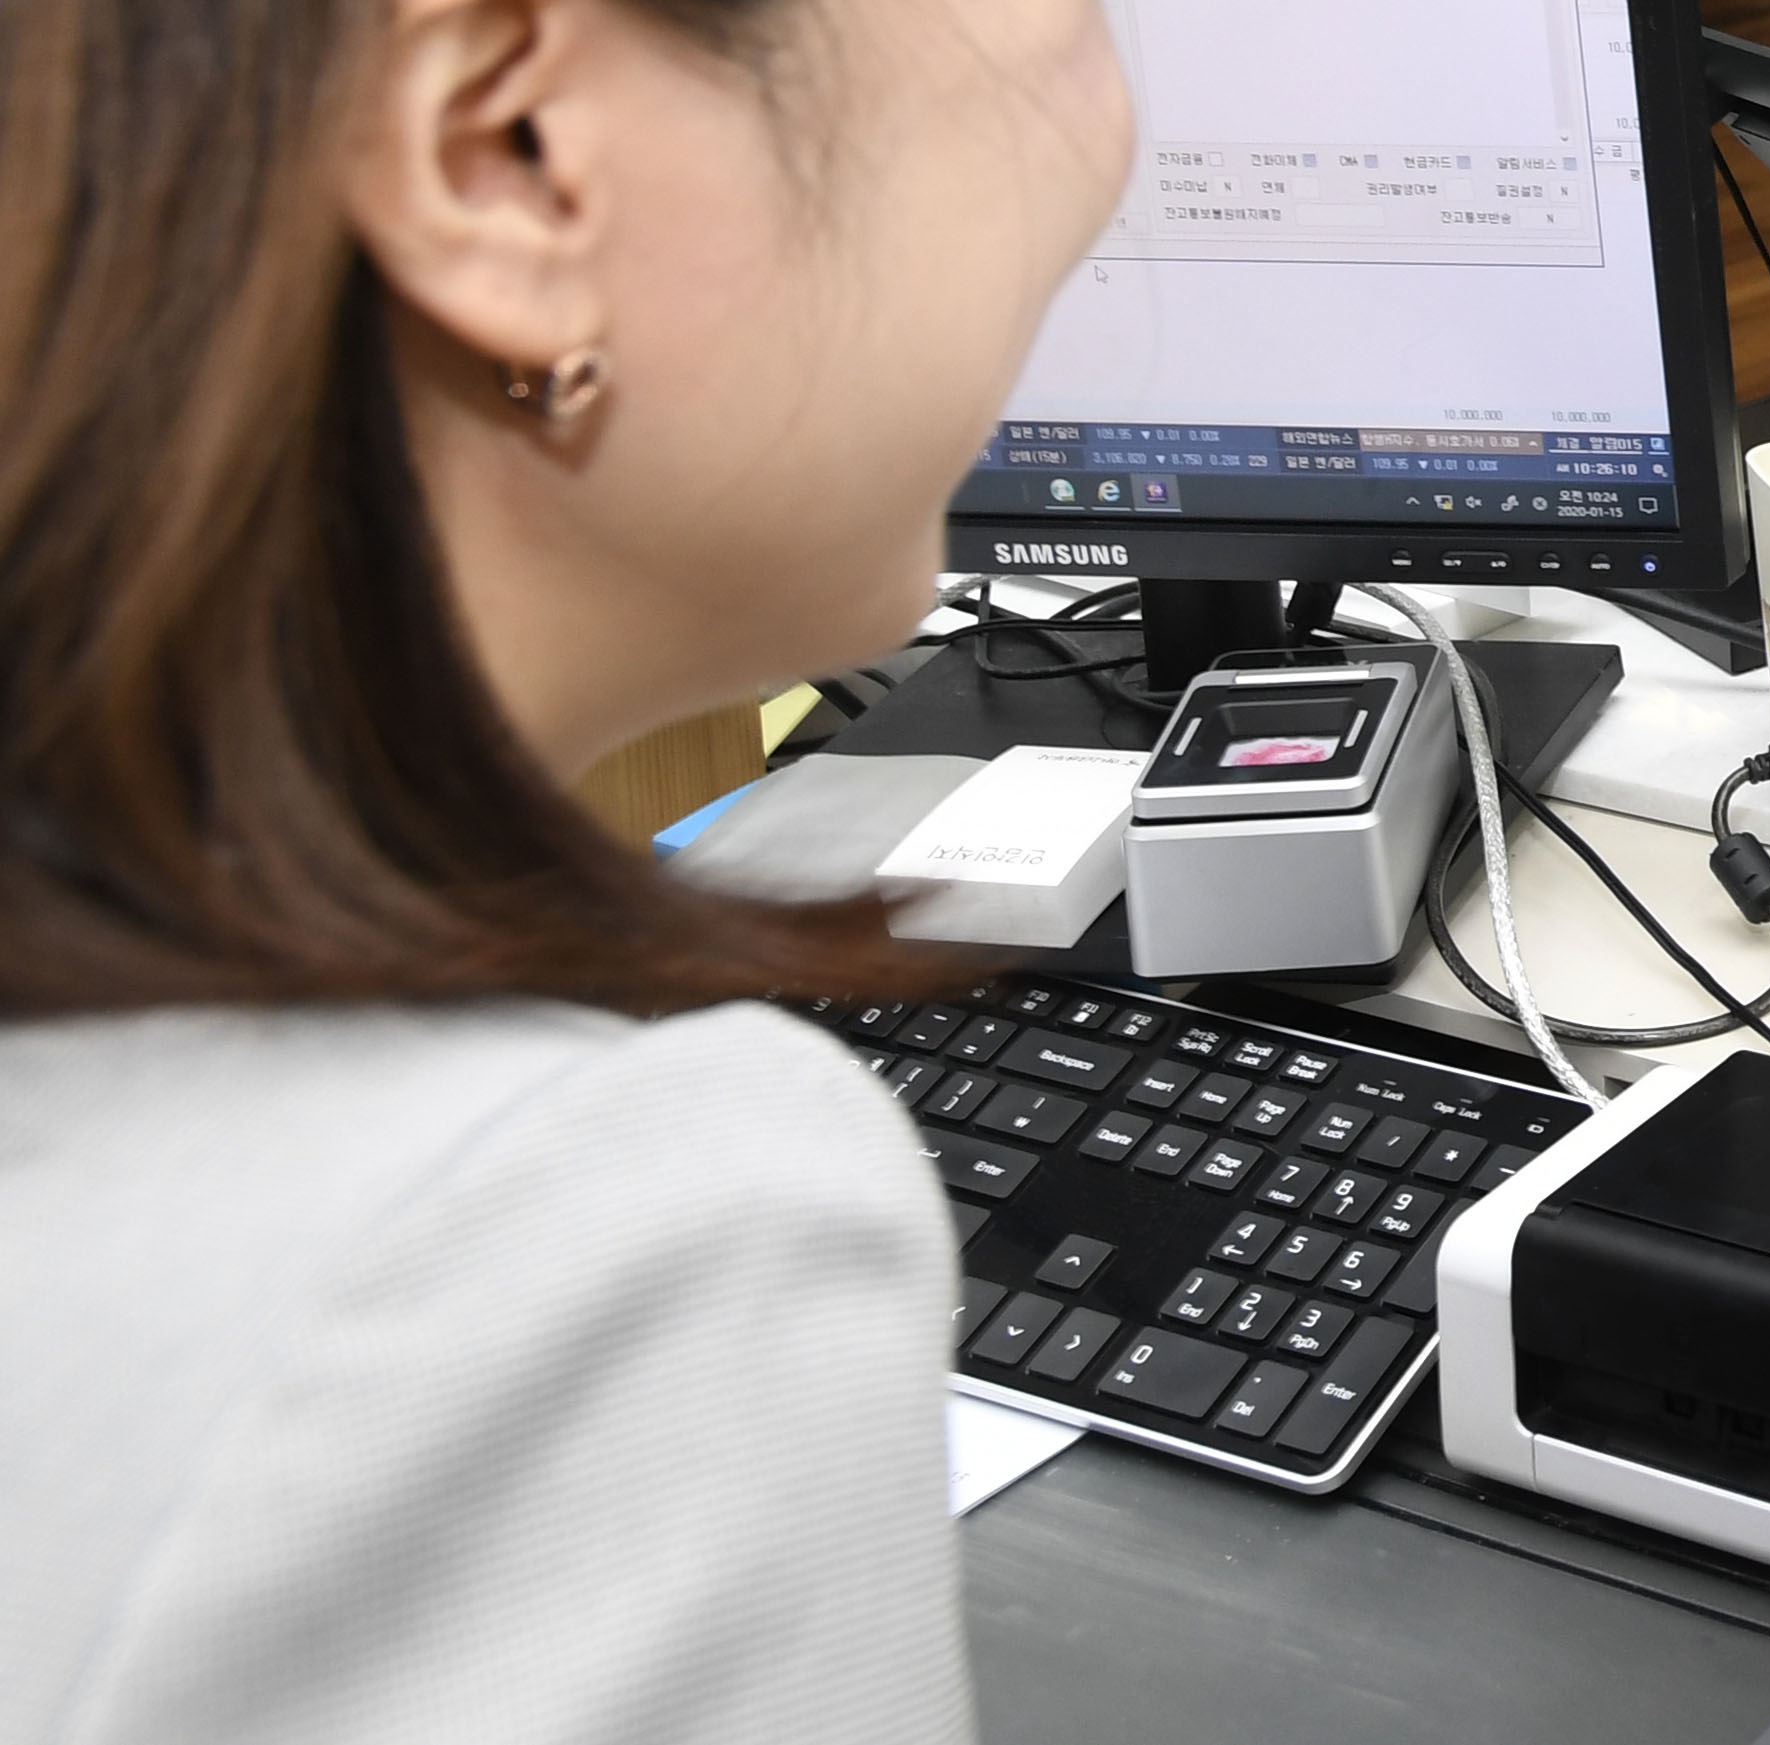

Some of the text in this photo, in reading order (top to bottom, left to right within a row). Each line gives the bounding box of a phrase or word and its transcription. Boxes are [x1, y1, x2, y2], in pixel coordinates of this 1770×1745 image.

[1573, 462, 1639, 476] 10:26:10
[1586, 491, 1619, 504] 10:24
[1557, 506, 1624, 519] 2020-01-15
[994, 543, 1129, 566] SAMSUNG
[1241, 1041, 1275, 1058] Scroll
[1037, 1049, 1096, 1071] Backspace
[1234, 1053, 1262, 1067] Lock
[1294, 1055, 1328, 1071] Pause
[1286, 1065, 1319, 1081] Break
[1143, 1077, 1176, 1093] Insert
[1355, 1082, 1406, 1102] Num Lock
[1200, 1090, 1228, 1105] Home
[1258, 1099, 1287, 1116] Page
[1431, 1101, 1483, 1121] Caps Lock
[1255, 1112, 1273, 1124] Up
[1329, 1115, 1354, 1130] Num
[1096, 1127, 1134, 1147] Delete
[1318, 1127, 1346, 1141] Lock
[1155, 1143, 1181, 1158] End
[972, 1159, 1007, 1177] Enter
[1212, 1152, 1243, 1169] Page
[1203, 1163, 1234, 1179] Down
[1280, 1165, 1300, 1182] 7
[1334, 1178, 1356, 1196] 8
[1267, 1188, 1296, 1204] Home
[1392, 1193, 1414, 1211] 9
[1236, 1223, 1257, 1239] 4
[1286, 1235, 1309, 1254] 5
[1342, 1250, 1365, 1269] 6
[1239, 1292, 1262, 1311] 2
[1177, 1303, 1204, 1319] End
[1300, 1309, 1323, 1328] 3
[1130, 1344, 1153, 1365] 0
[1114, 1370, 1135, 1385] Ins
[1320, 1382, 1358, 1401] Enter
[1231, 1400, 1256, 1417] Del
